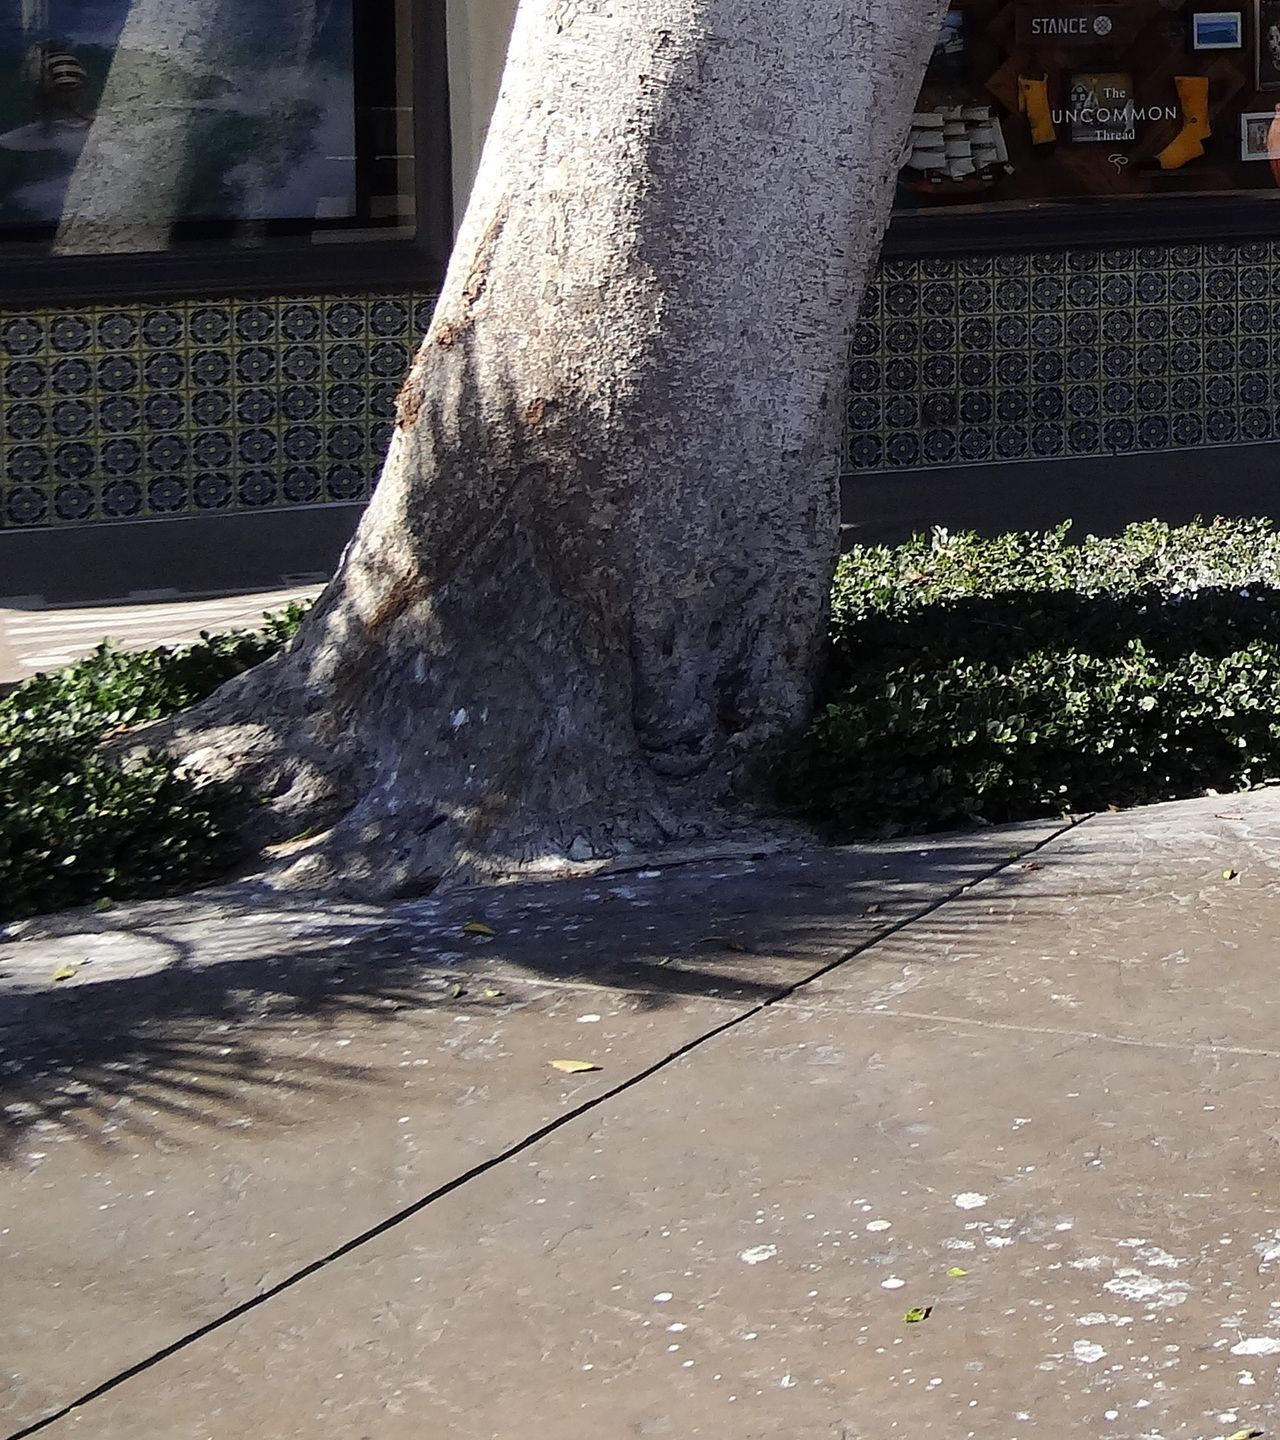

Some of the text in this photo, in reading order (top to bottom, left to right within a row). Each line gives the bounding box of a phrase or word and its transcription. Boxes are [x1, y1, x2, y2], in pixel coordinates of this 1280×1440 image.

[1031, 18, 1087, 34] STANCE
[1104, 87, 1126, 99] The
[1052, 106, 1177, 124] UNCOMMON
[1096, 129, 1135, 141] Thread
